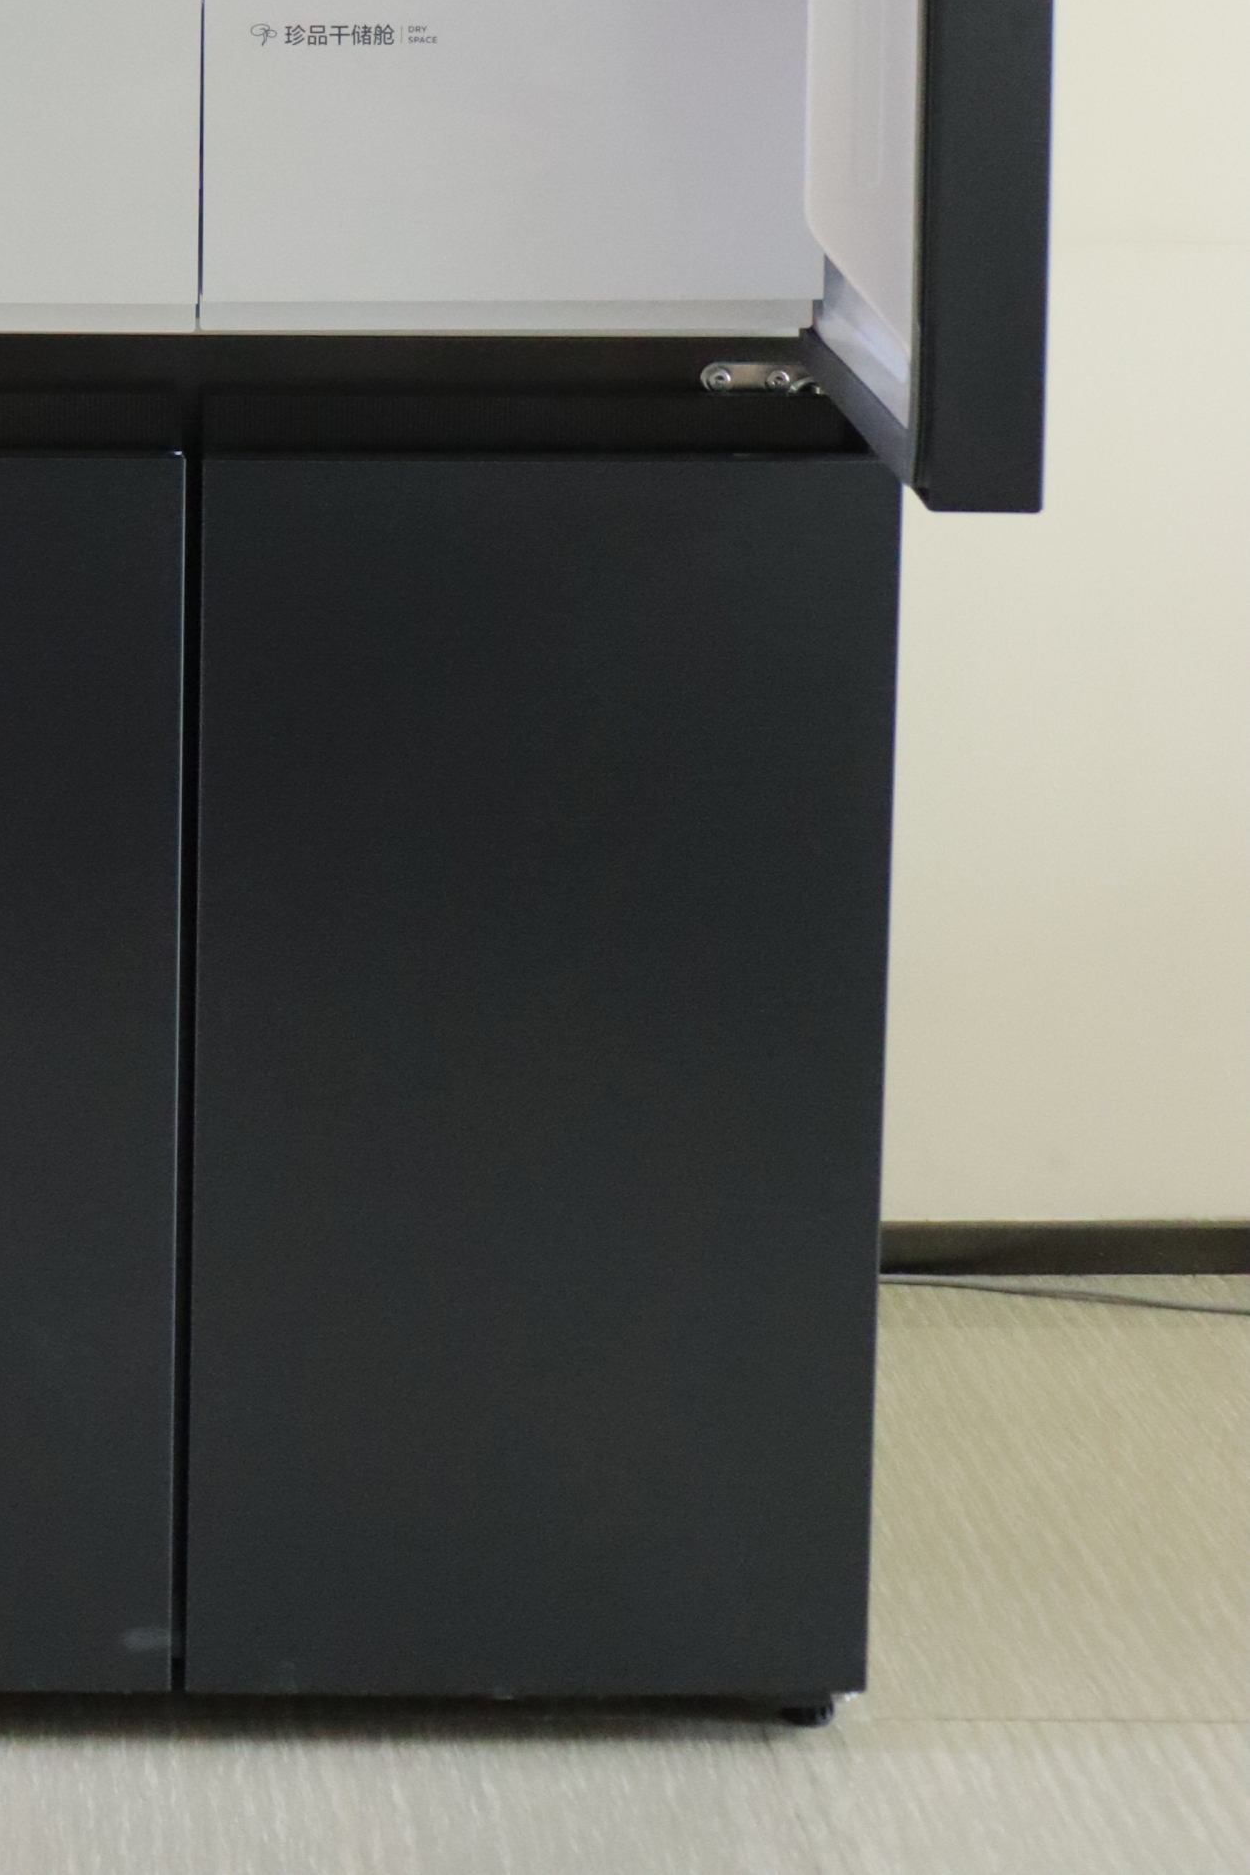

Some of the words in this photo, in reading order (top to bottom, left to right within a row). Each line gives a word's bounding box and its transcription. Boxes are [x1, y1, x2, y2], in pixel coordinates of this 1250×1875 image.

[408, 25, 428, 33] DRY
[284, 23, 395, 46] 珍品干储舱
[408, 36, 438, 44] SPACE
